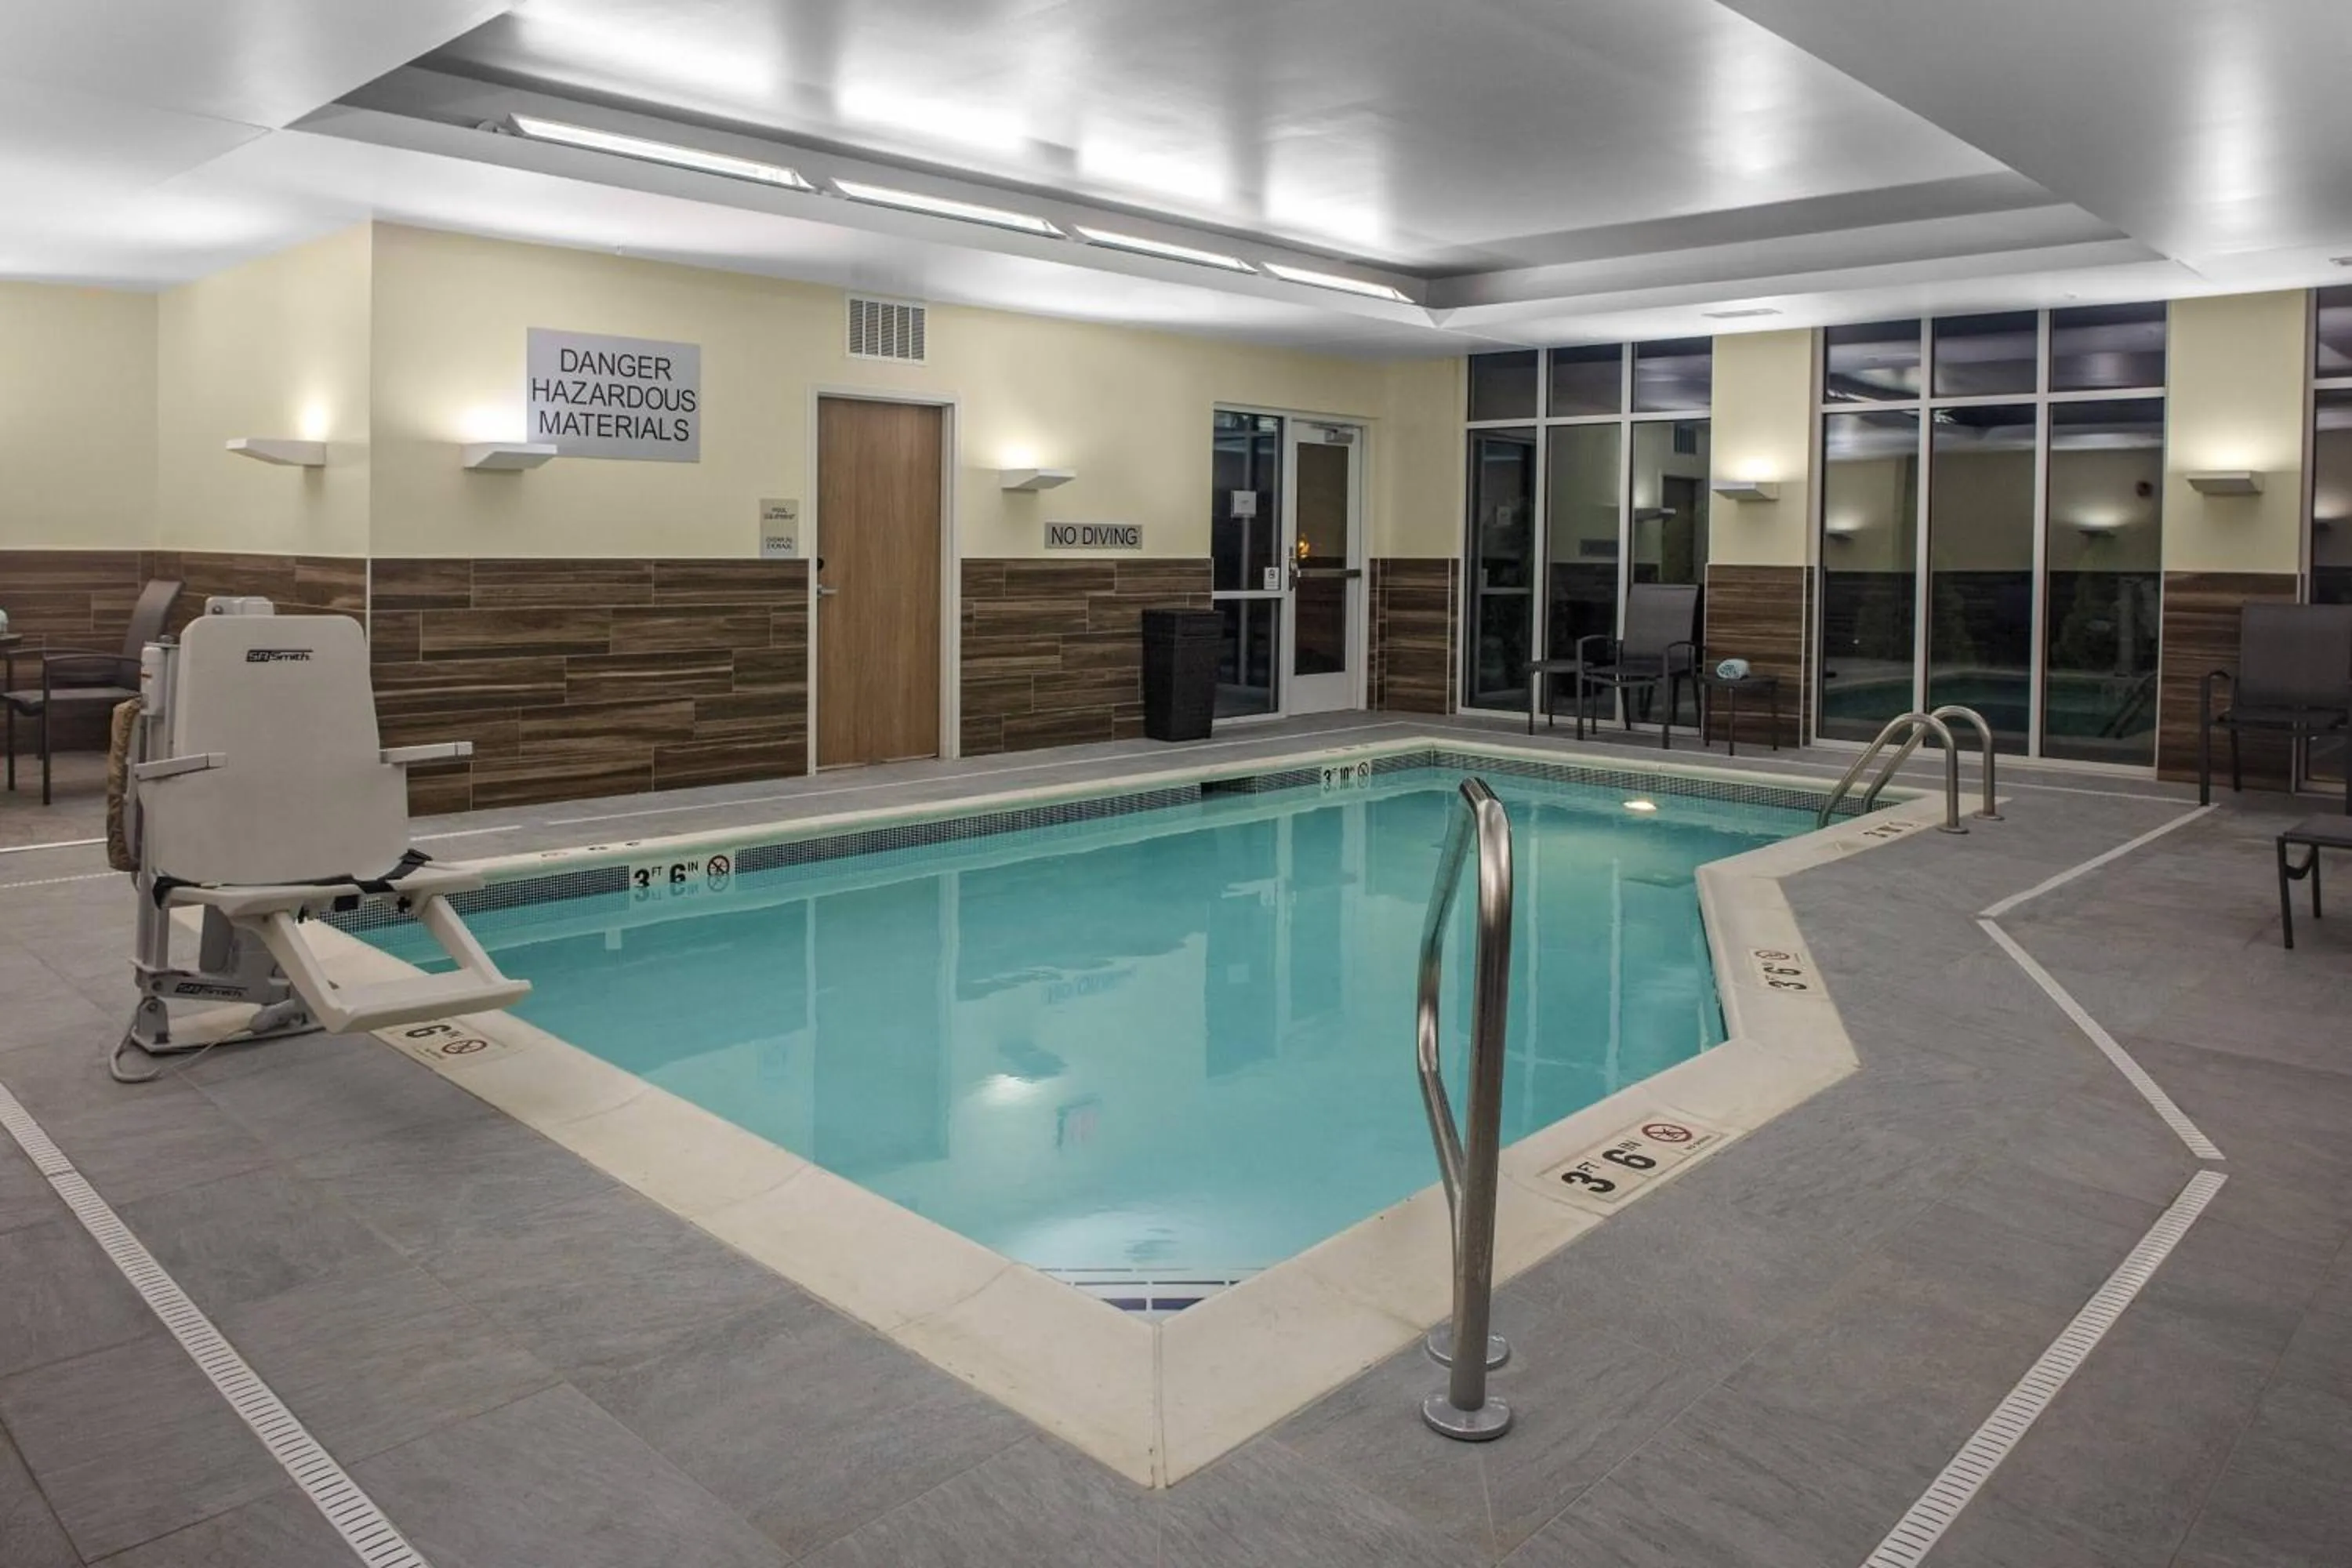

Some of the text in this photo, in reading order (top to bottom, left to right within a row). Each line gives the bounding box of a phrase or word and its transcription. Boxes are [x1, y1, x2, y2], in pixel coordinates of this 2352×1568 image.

[561, 348, 672, 381] DANGER
[532, 377, 696, 412] HAZARDOUS
[539, 410, 690, 441] MATERIALS
[1051, 526, 1138, 545] NO DIVING
[634, 861, 699, 887] 3 FT 6 IN
[405, 1025, 452, 1038] 6
[1577, 1161, 1600, 1174] FT
[1602, 1149, 1657, 1170] 6
[1561, 1171, 1615, 1193] 3
